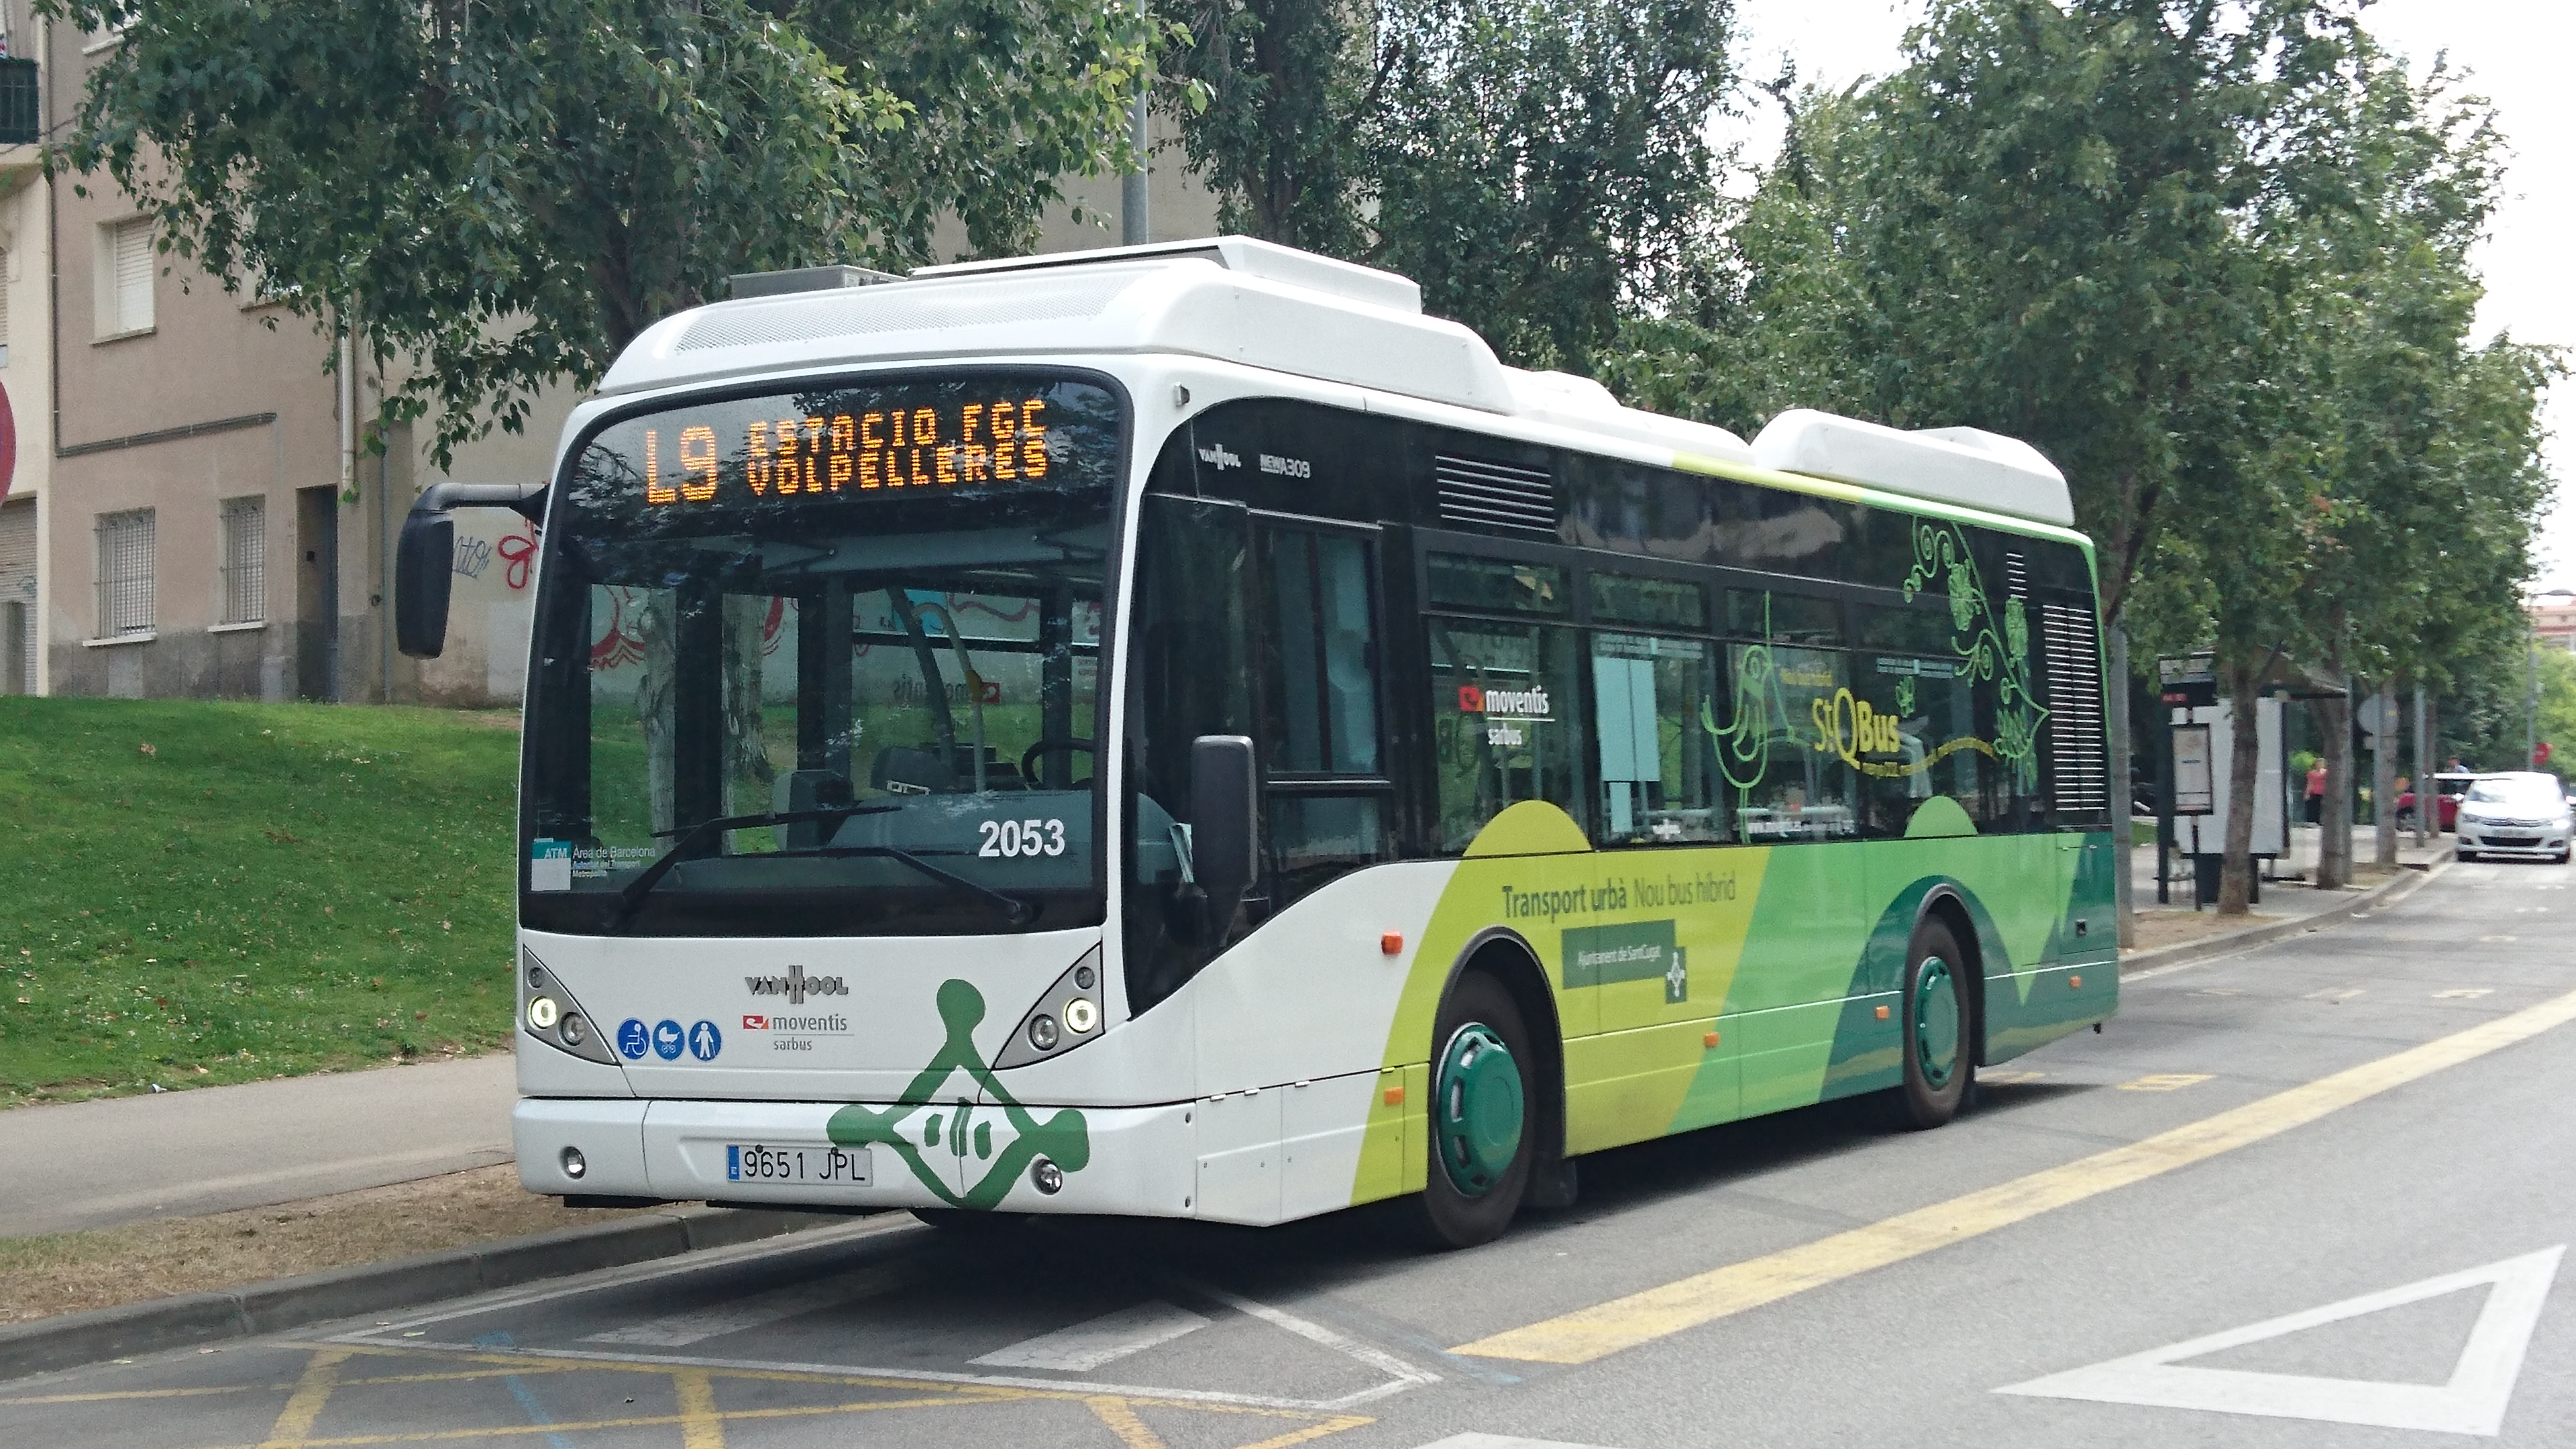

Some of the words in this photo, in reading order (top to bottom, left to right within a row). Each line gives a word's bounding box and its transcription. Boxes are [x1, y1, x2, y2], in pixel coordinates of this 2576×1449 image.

[749, 407, 937, 457] ESTACIO
[962, 399, 1047, 443] FGC
[645, 425, 716, 503] L9
[747, 439, 1048, 496] VOLPELLERES
[1485, 684, 1550, 714] moventis
[1488, 723, 1522, 745] sarbus
[596, 846, 608, 858] de
[610, 845, 655, 859] Barcelona
[979, 818, 1065, 857] 2053
[544, 847, 568, 859] ATM
[1502, 885, 1586, 924] Transport
[1591, 877, 1627, 912] urbà
[1634, 877, 1663, 907] Nou
[1668, 873, 1693, 905] bus
[1618, 946, 1627, 961] de
[773, 1014, 847, 1032] moventis
[773, 1038, 813, 1051] sarbus
[744, 1150, 804, 1178] 9651
[819, 1152, 865, 1181] JPL
